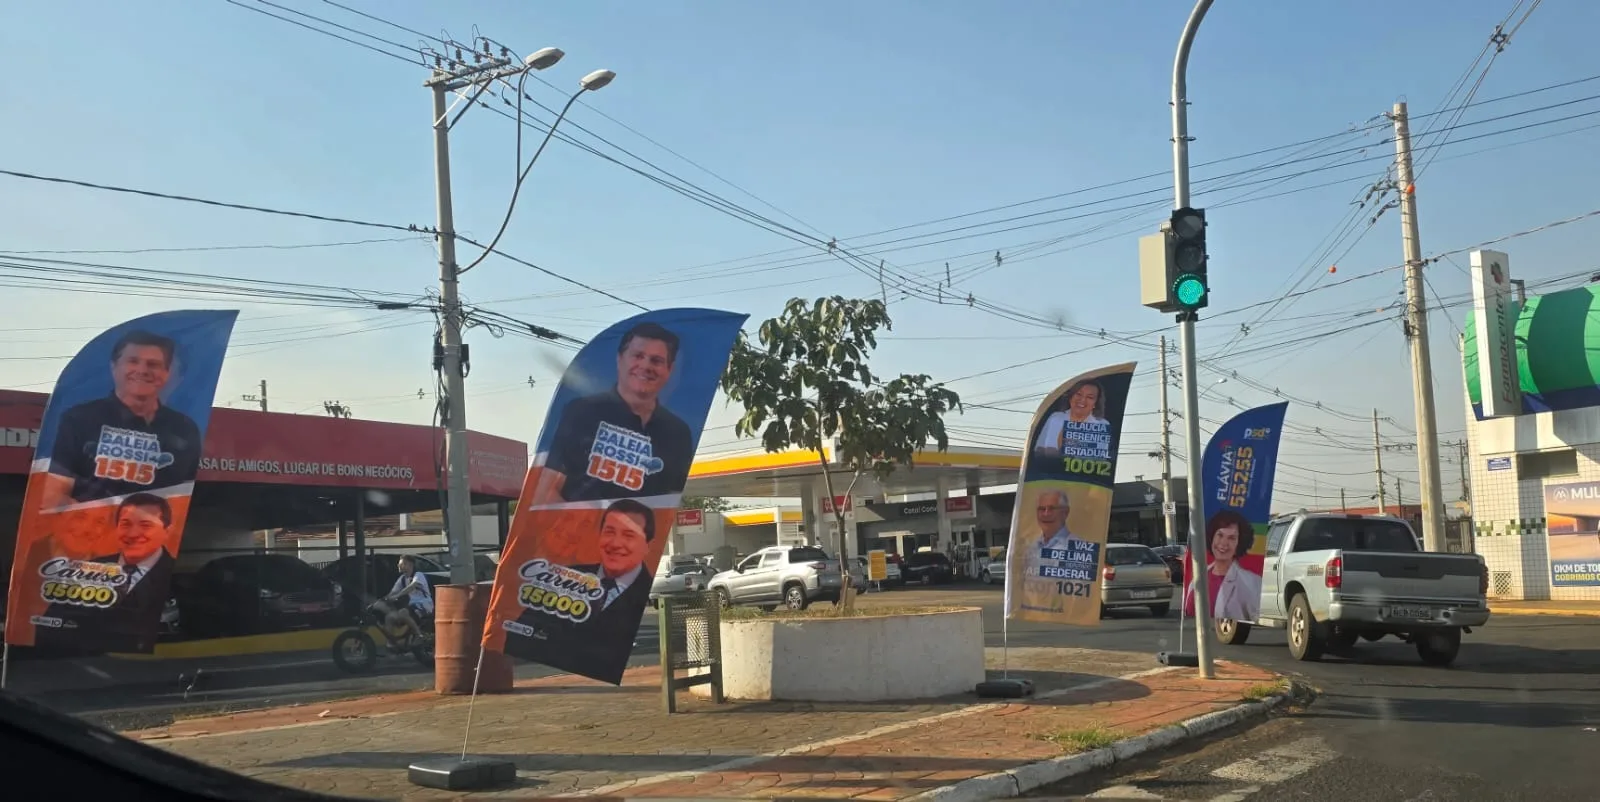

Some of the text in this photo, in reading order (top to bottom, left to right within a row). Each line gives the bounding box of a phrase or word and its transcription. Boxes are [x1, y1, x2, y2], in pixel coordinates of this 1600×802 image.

[102, 432, 159, 452] BALEIA
[598, 428, 651, 457] BALEIA
[1065, 432, 1111, 443] BERENICE
[98, 444, 149, 463] ROSSI
[593, 441, 640, 466] ROSSI
[1064, 446, 1112, 458] ESTADUAL
[96, 456, 154, 484] 1515
[198, 458, 218, 470] ASA
[220, 458, 235, 471] DE
[284, 462, 319, 475] LUGAR
[322, 463, 336, 475] DE
[337, 464, 364, 477] BONS
[588, 455, 644, 488] 1515
[1064, 457, 1112, 476] 10012
[1216, 451, 1233, 501] FLÁVIA
[1229, 446, 1253, 508] 55255
[1074, 541, 1095, 551] VAZ
[1051, 550, 1093, 562] DE LIMA
[41, 559, 126, 583] Caruso
[1045, 567, 1092, 580] FEDERAL
[1555, 573, 1595, 581] COBRIMOS
[1574, 563, 1586, 573] DE
[521, 561, 603, 598] Caruso
[44, 582, 112, 604] 15000
[1055, 581, 1091, 598] 1021
[521, 585, 587, 617] 15000
